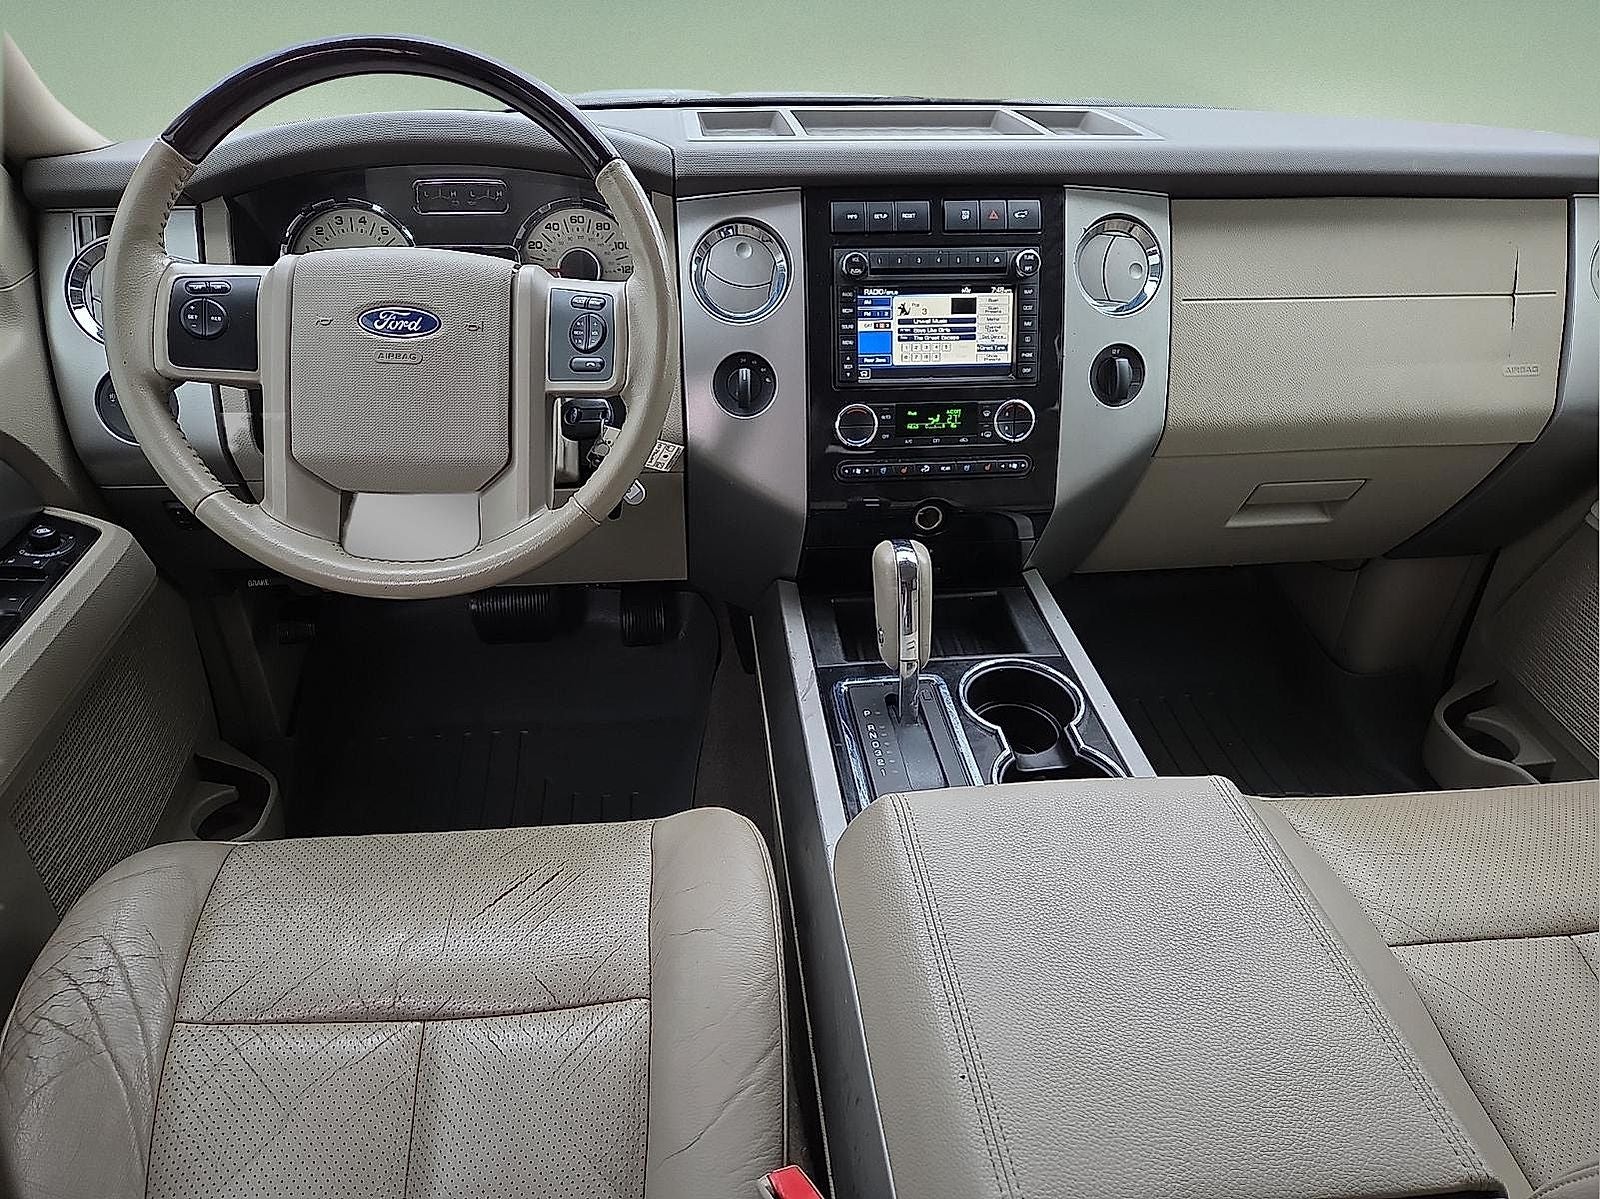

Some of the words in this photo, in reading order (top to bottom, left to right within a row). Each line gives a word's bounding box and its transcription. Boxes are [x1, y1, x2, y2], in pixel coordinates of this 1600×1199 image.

[334, 216, 344, 225] 3
[358, 216, 367, 225] 4
[570, 215, 585, 224] 60
[315, 226, 325, 235] 2
[381, 226, 390, 236] 5
[545, 223, 560, 231] 40
[595, 223, 611, 231] 80
[528, 241, 543, 250] 20
[374, 310, 423, 332] Ford
[377, 352, 417, 360] AIRBAG
[869, 732, 878, 740] N
